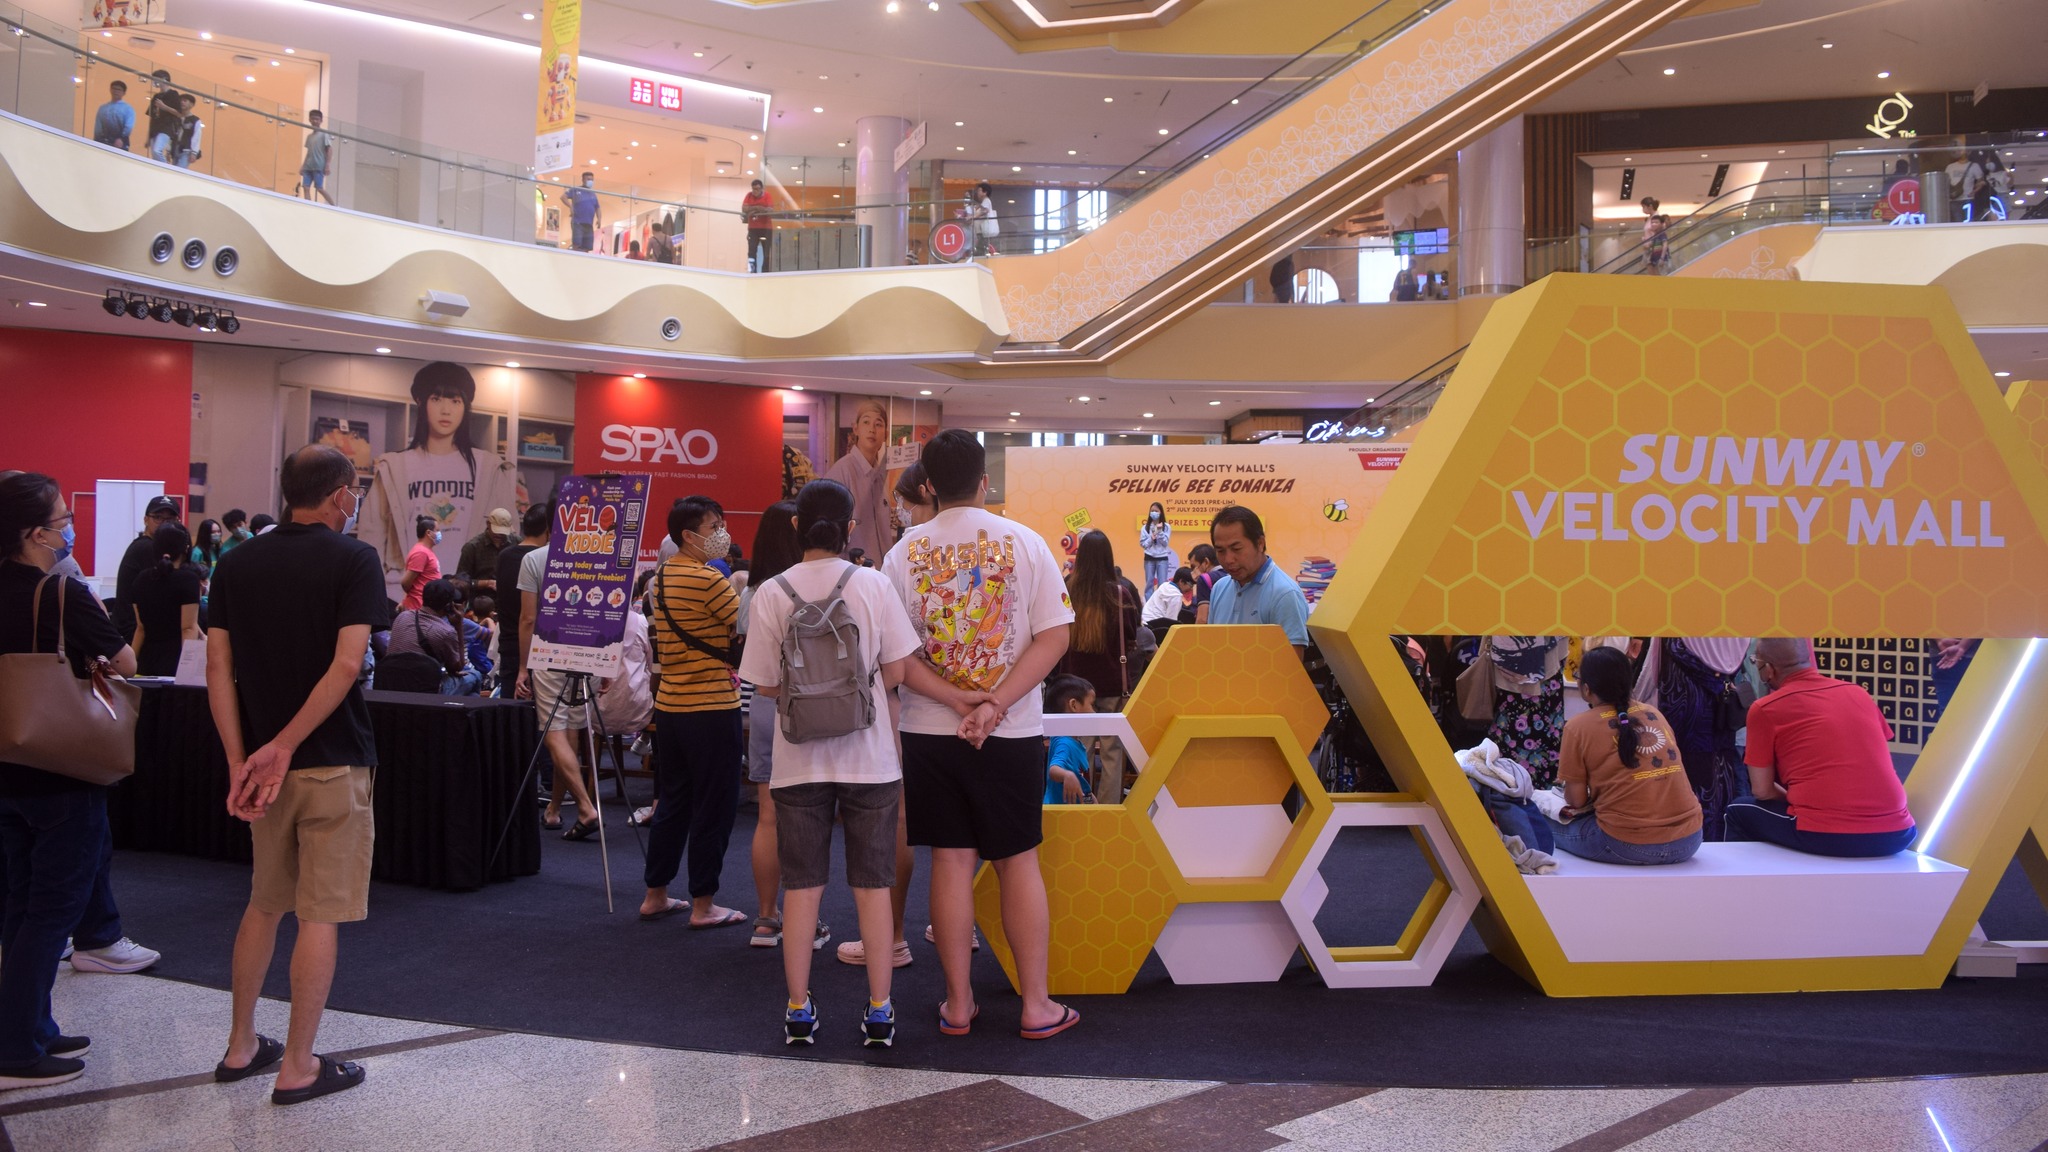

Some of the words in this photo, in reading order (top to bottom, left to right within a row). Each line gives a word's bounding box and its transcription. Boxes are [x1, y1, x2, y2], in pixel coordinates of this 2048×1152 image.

[1866, 92, 1914, 139] KOI
[1900, 191, 1914, 204] L1
[943, 234, 955, 245] L1
[600, 424, 718, 465] SPAO
[1127, 464, 1174, 473] SUNWAY
[1177, 464, 1233, 473] VELOCITY
[1236, 464, 1275, 473] MALL'S
[1618, 433, 1905, 488] SUNWAY
[408, 480, 475, 500] WOODIE
[1108, 478, 1181, 494] SPELLING
[1185, 478, 1215, 494] BEE
[1219, 478, 1296, 494] BONANZA
[558, 502, 618, 534] VELO
[1169, 519, 1199, 527] PRIZES
[1511, 491, 1825, 545] VELOCITY
[1846, 498, 2006, 548] MALL
[563, 532, 617, 555] KIDDIE
[908, 528, 1016, 576] Sushi
[550, 559, 564, 569] Sign
[565, 562, 574, 570] up
[575, 561, 593, 570] today
[594, 562, 608, 570] and
[548, 570, 570, 579] receive
[571, 571, 596, 581] Mystery
[597, 573, 627, 582] Freebies!
